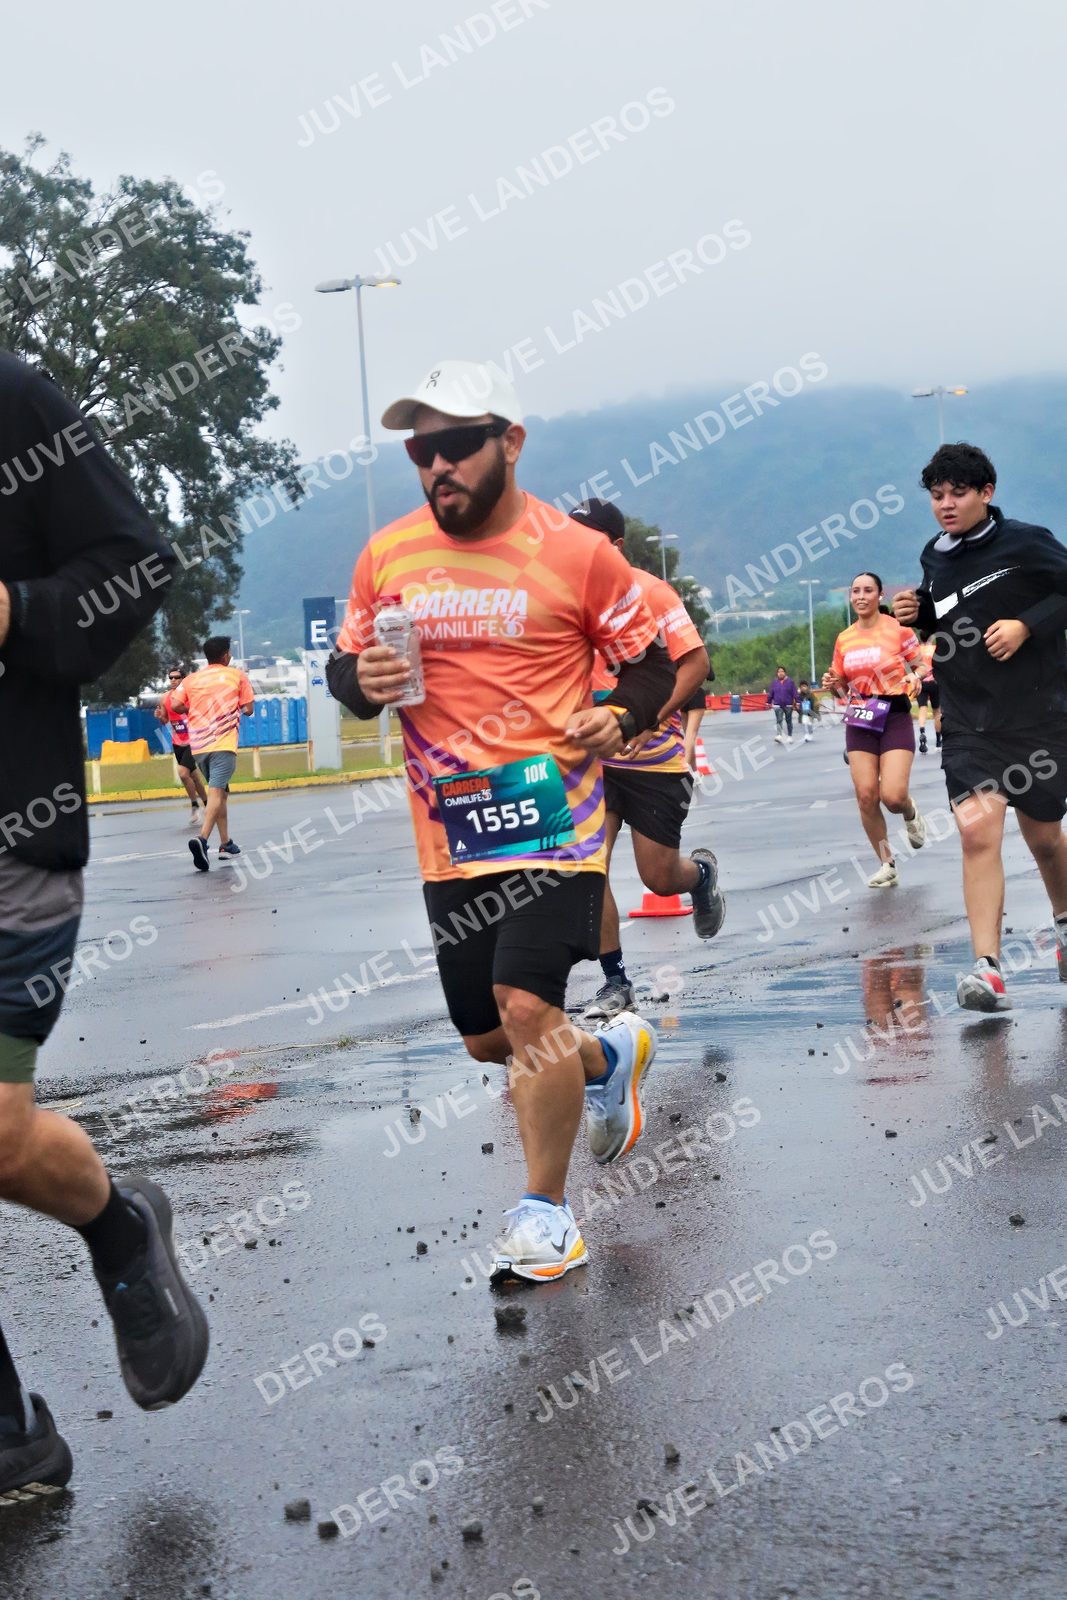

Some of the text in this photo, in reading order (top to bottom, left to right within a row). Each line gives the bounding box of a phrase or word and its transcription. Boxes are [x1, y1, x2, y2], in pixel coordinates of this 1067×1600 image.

[408, 588, 528, 620] CARRERA
[311, 619, 328, 642] E
[854, 709, 874, 721] 728
[524, 762, 549, 784] 10K
[442, 776, 490, 797] CARRERA
[445, 793, 482, 807] OMNILIFE
[466, 798, 540, 833] 1555
